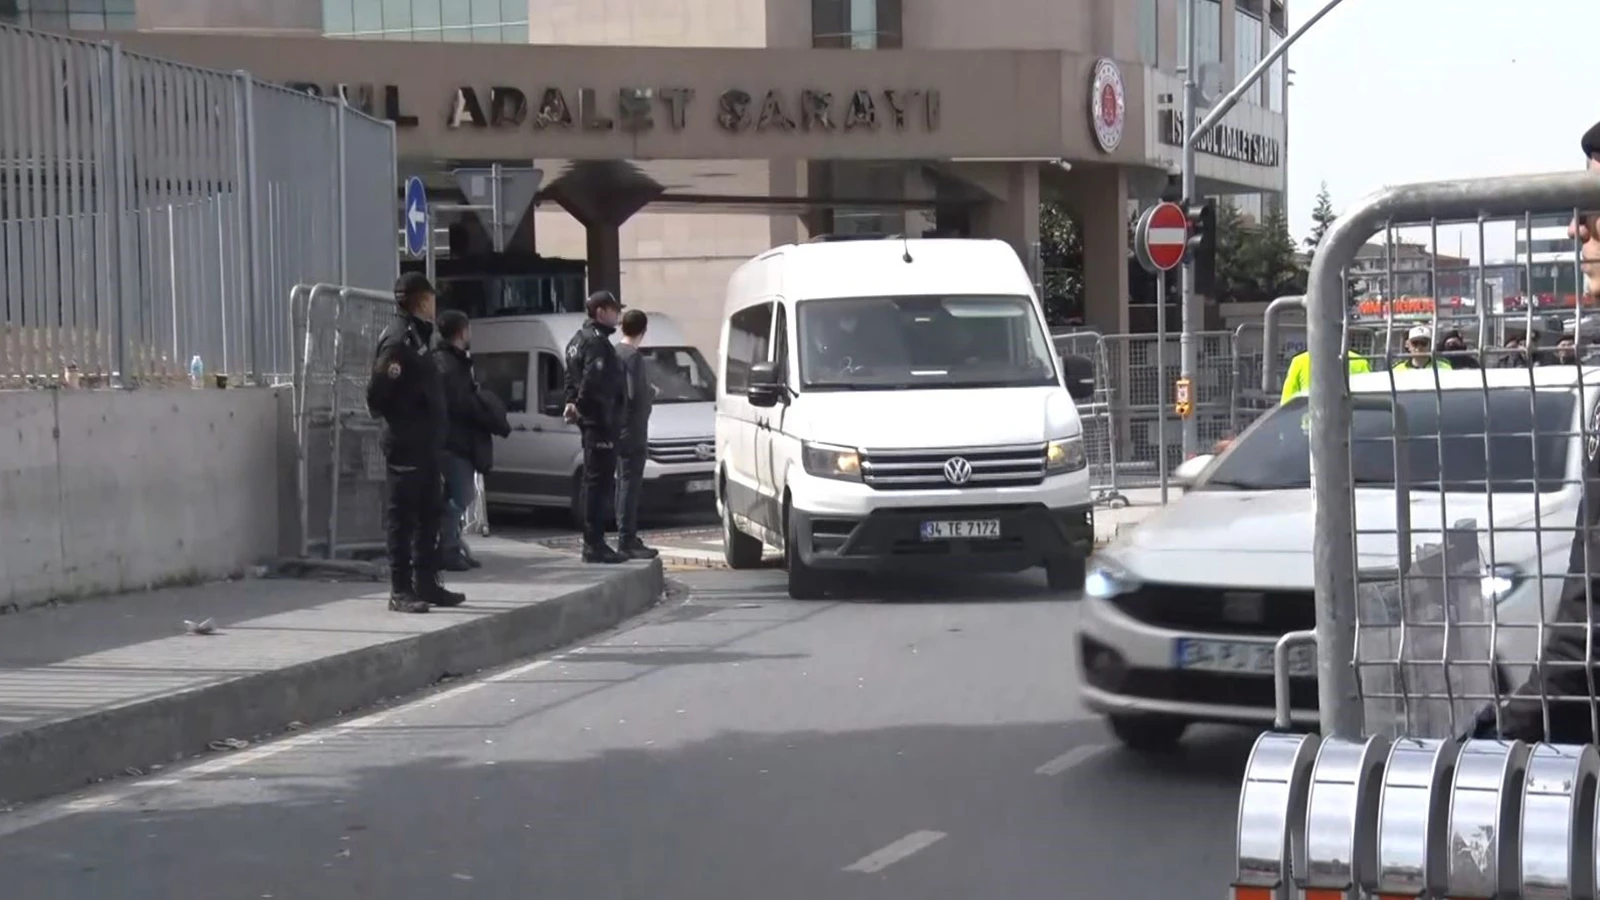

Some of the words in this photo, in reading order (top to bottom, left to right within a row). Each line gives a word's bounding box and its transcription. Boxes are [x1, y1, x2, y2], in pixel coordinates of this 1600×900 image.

[447, 86, 695, 130] ADALET
[717, 89, 940, 133] SARAYI
[928, 521, 942, 536] 34
[948, 521, 962, 536] TE
[967, 521, 997, 535] 7172
